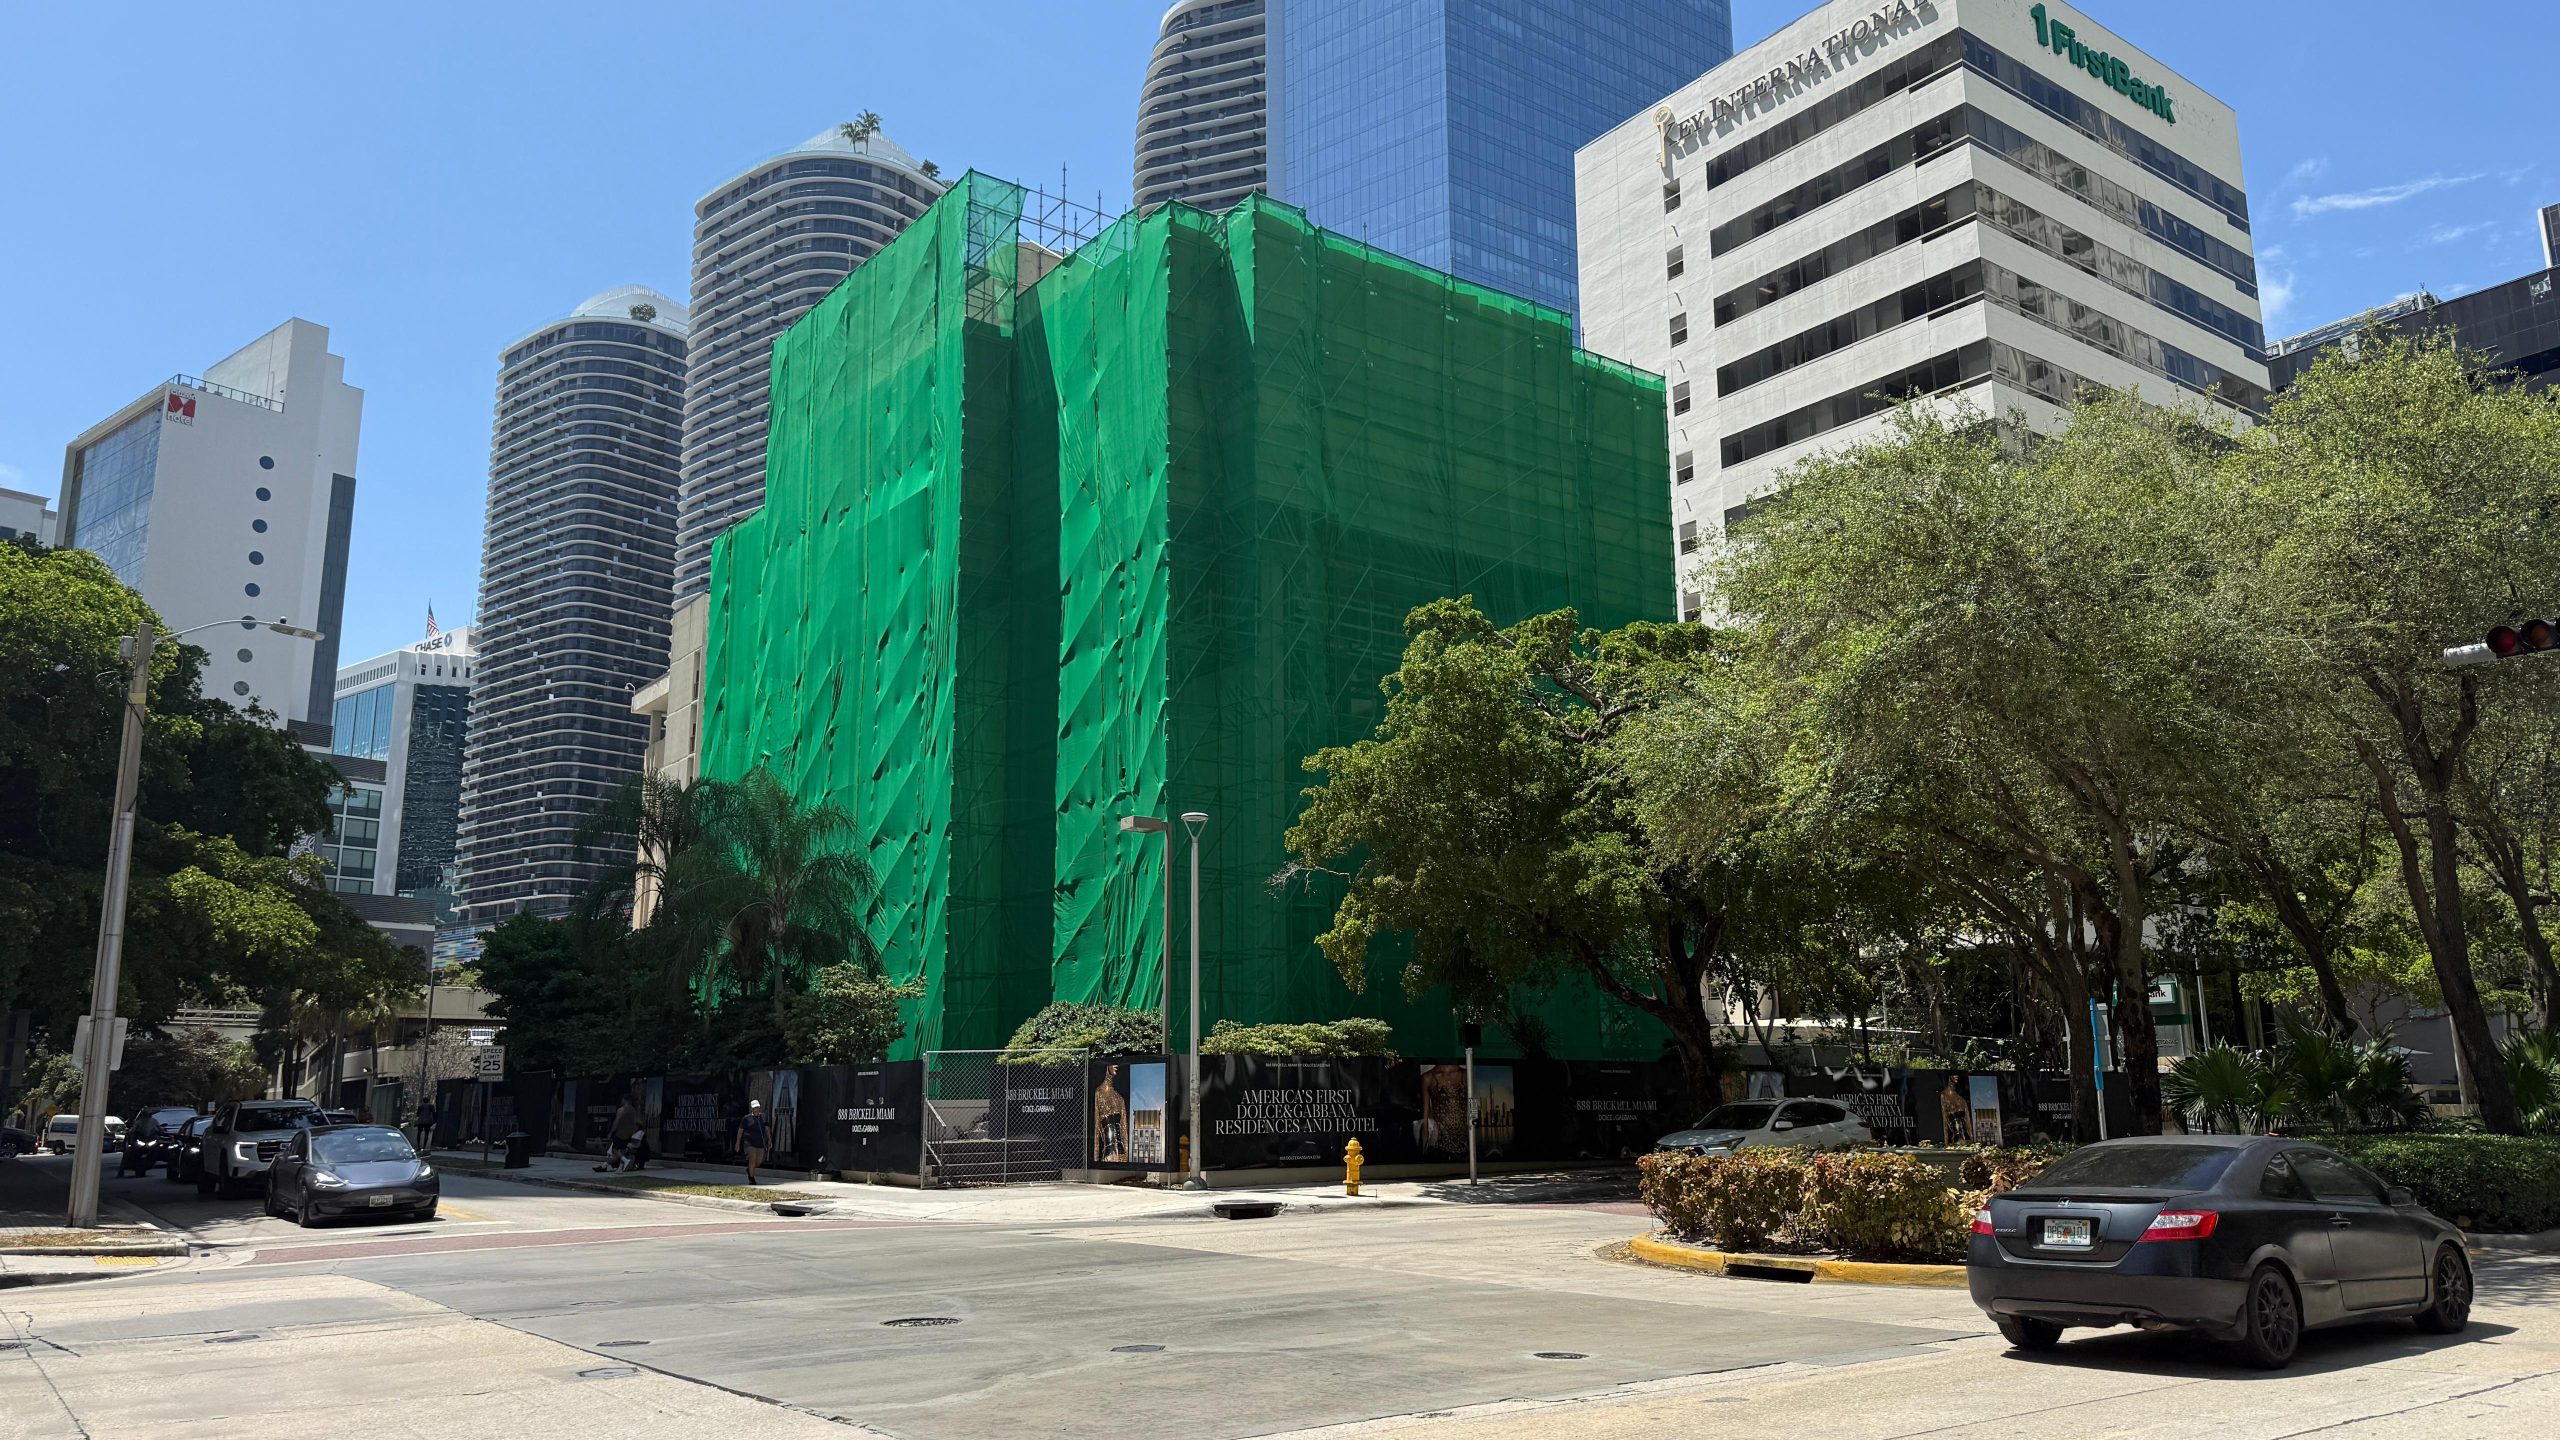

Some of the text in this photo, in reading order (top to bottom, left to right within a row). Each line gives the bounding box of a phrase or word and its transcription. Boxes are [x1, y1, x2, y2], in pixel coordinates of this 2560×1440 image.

[1657, 110, 1706, 148] KEY
[166, 411, 193, 427] hotel
[414, 636, 443, 652] CHASE
[482, 1060, 501, 1071] 25
[1017, 1088, 1050, 1100] BRICKELL
[1051, 1087, 1074, 1099] MIAMI
[1241, 1089, 1352, 1105] AMERICA'S FIRST
[1875, 1094, 1898, 1105] FIRST
[1237, 1103, 1357, 1119] DOLCE&GABBANA
[1576, 1100, 1657, 1111] 888 BRICKELL MIAMI
[2038, 1102, 2048, 1111] 888
[837, 1107, 896, 1120] 888 BRICKELL MIAMI
[1215, 1117, 1379, 1135] RESIDENCES AND HOTEL
[1870, 1116, 1916, 1128] AND HOTEL
